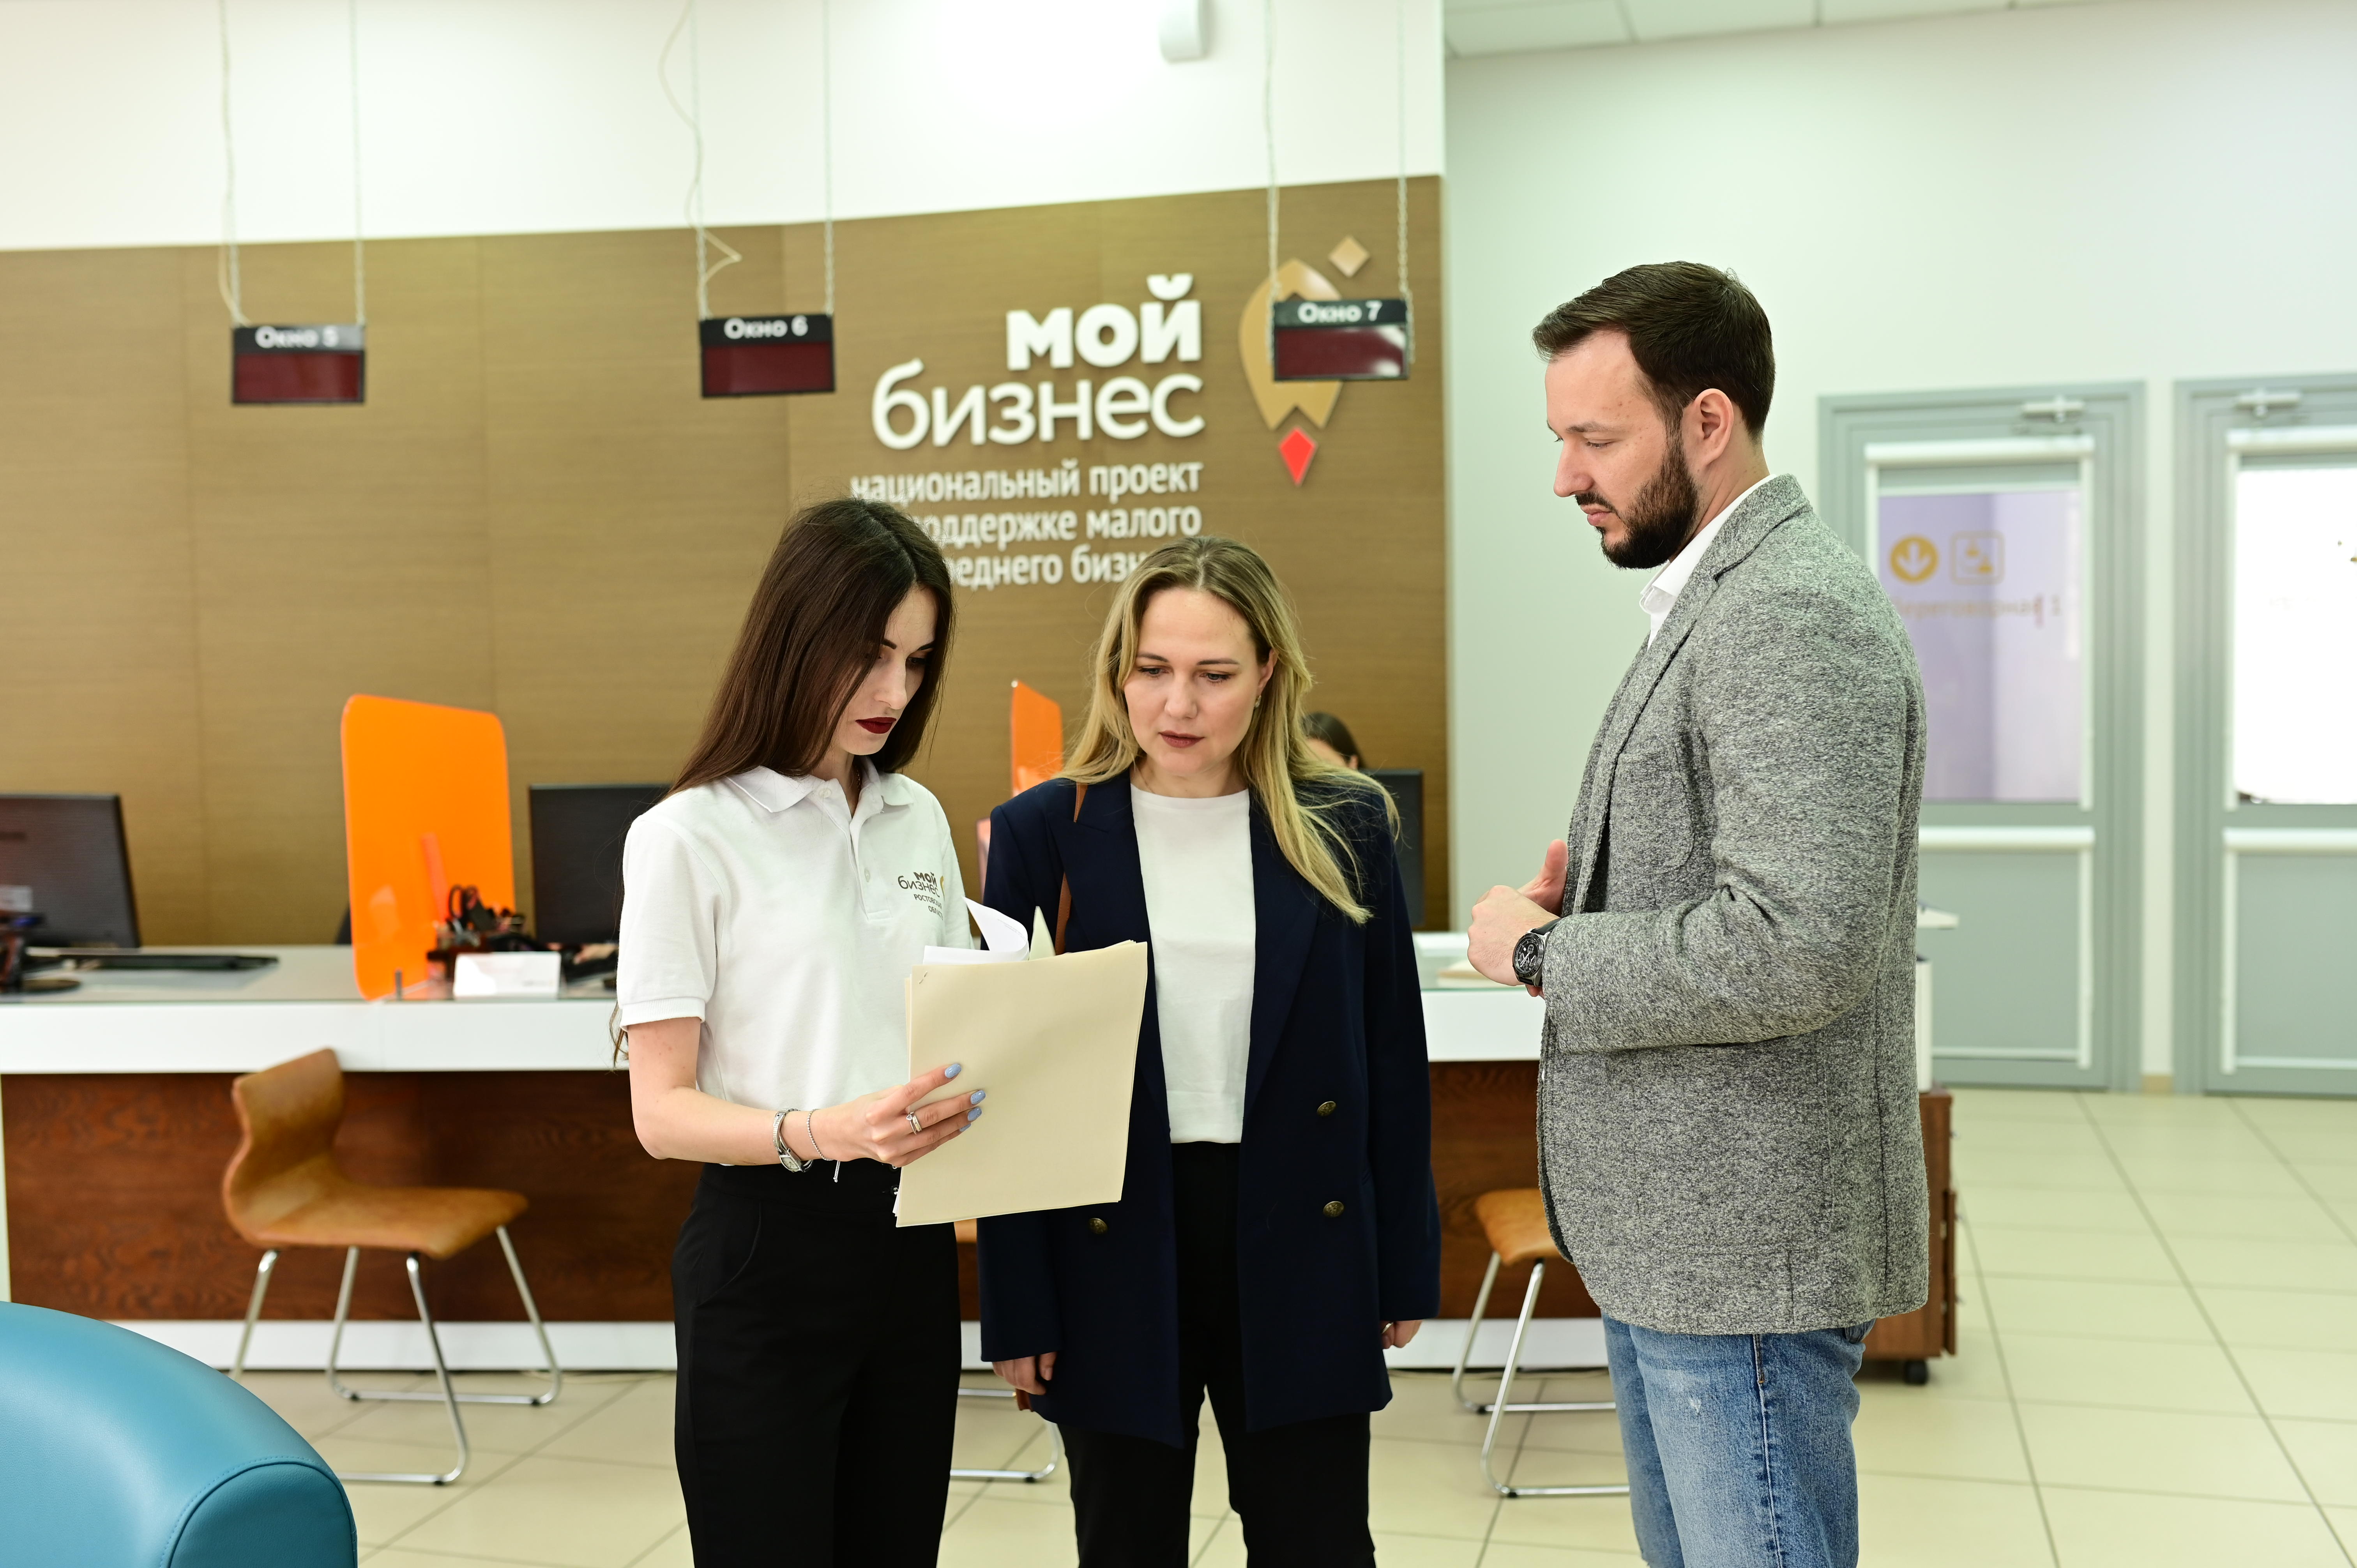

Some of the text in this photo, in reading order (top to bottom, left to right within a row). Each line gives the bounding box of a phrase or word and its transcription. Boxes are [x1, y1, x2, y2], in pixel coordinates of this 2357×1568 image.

[1006, 273, 1202, 371] мой
[1297, 300, 1382, 323] Окно 7
[255, 326, 319, 348] Окно
[724, 315, 808, 339] Окно 6
[871, 358, 1205, 450] бизнес
[851, 458, 1203, 505] национальный проект
[1086, 506, 1202, 539] малого
[943, 554, 1062, 591] еднего
[898, 876, 940, 897] бизнес
[928, 906, 943, 920] ОБЛАСТ
